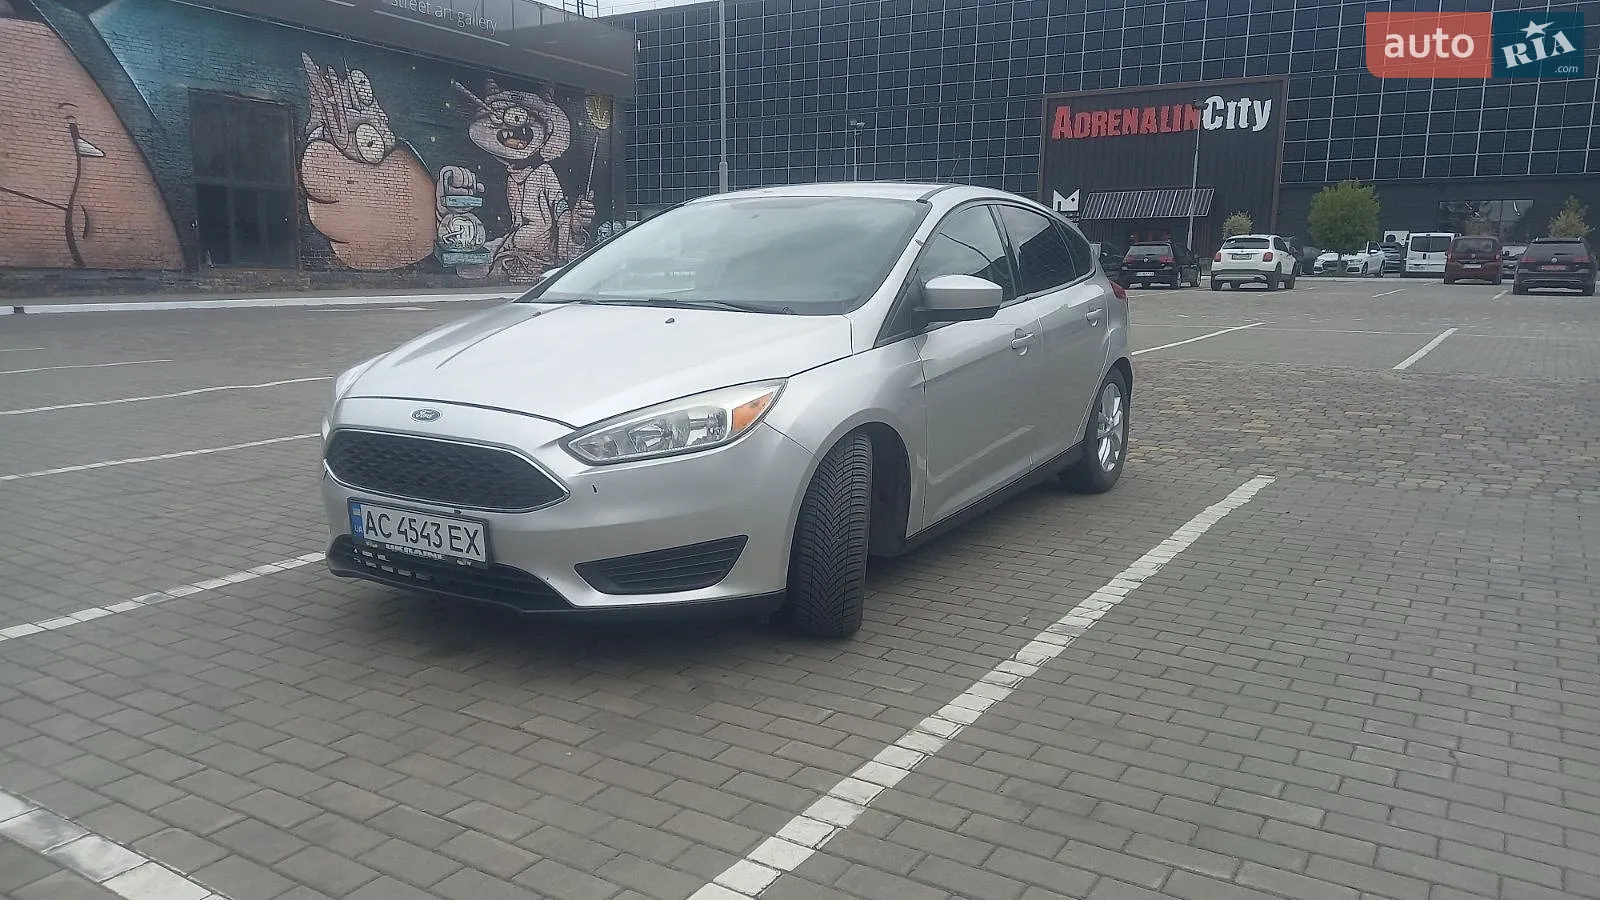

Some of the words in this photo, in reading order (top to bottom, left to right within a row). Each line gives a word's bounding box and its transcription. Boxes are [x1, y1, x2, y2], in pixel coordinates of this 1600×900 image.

[434, 5, 454, 20] art
[457, 11, 497, 36] gallery
[365, 510, 392, 539] AC
[397, 516, 443, 548] 4543
[447, 524, 481, 556] EX
